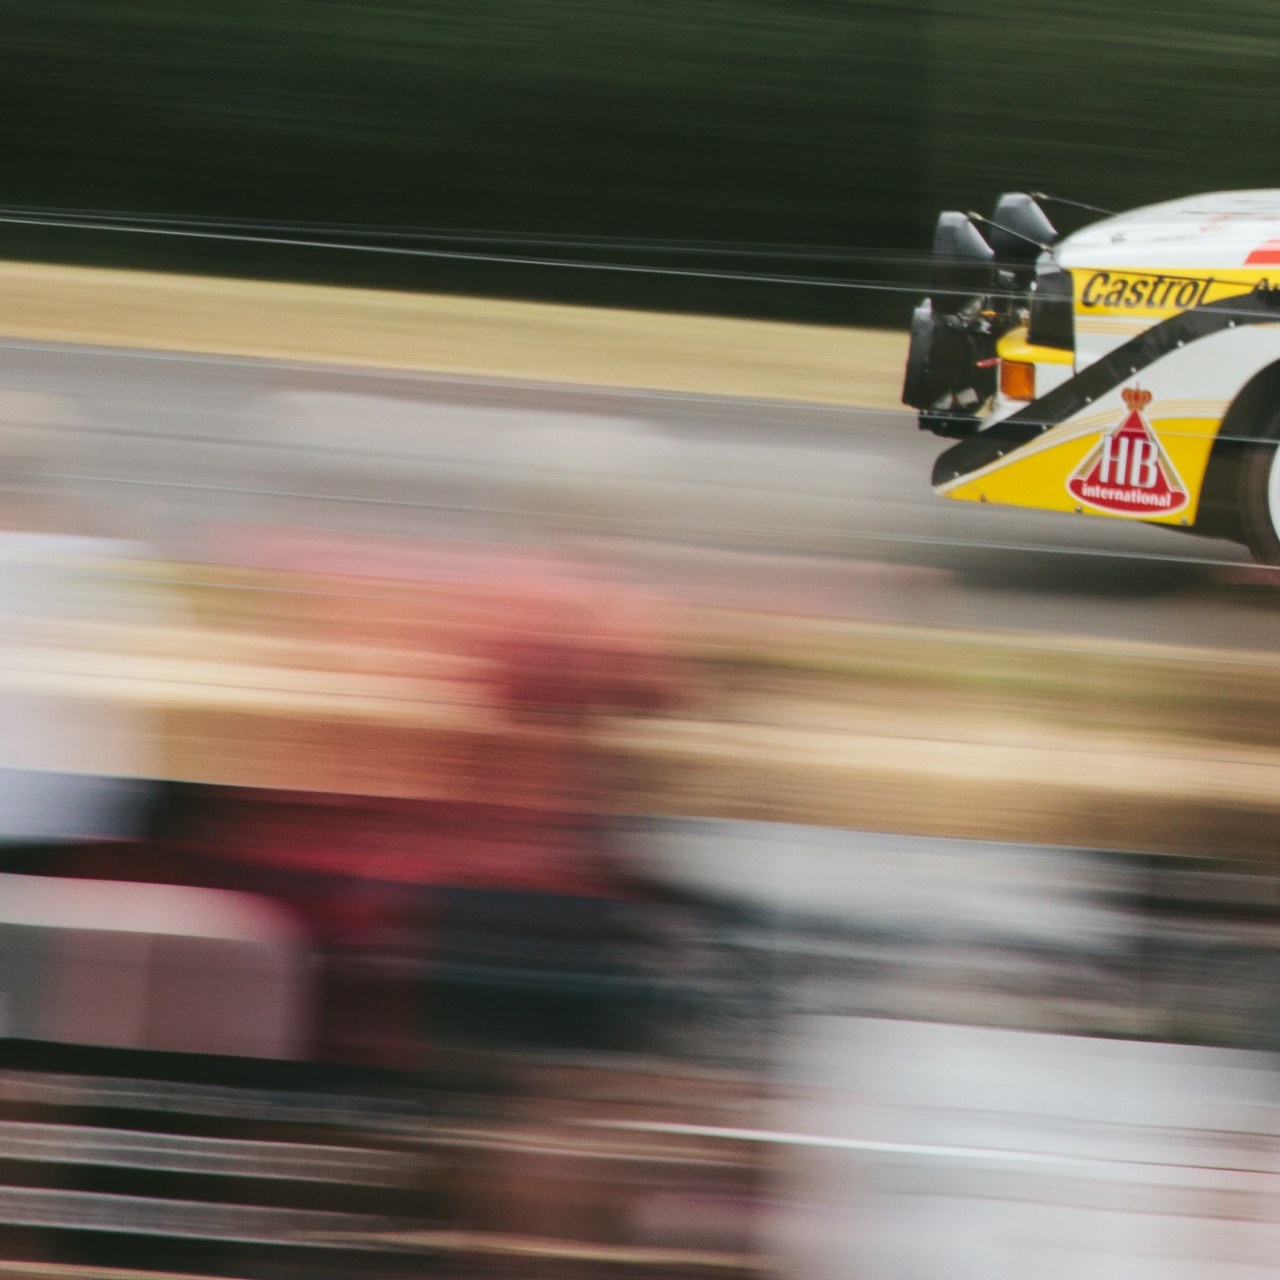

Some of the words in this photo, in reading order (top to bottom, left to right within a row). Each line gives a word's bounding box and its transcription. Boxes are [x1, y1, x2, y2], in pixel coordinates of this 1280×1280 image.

[1082, 272, 1215, 308] Castrol
[1098, 434, 1159, 489] HB
[1081, 482, 1172, 508] international
